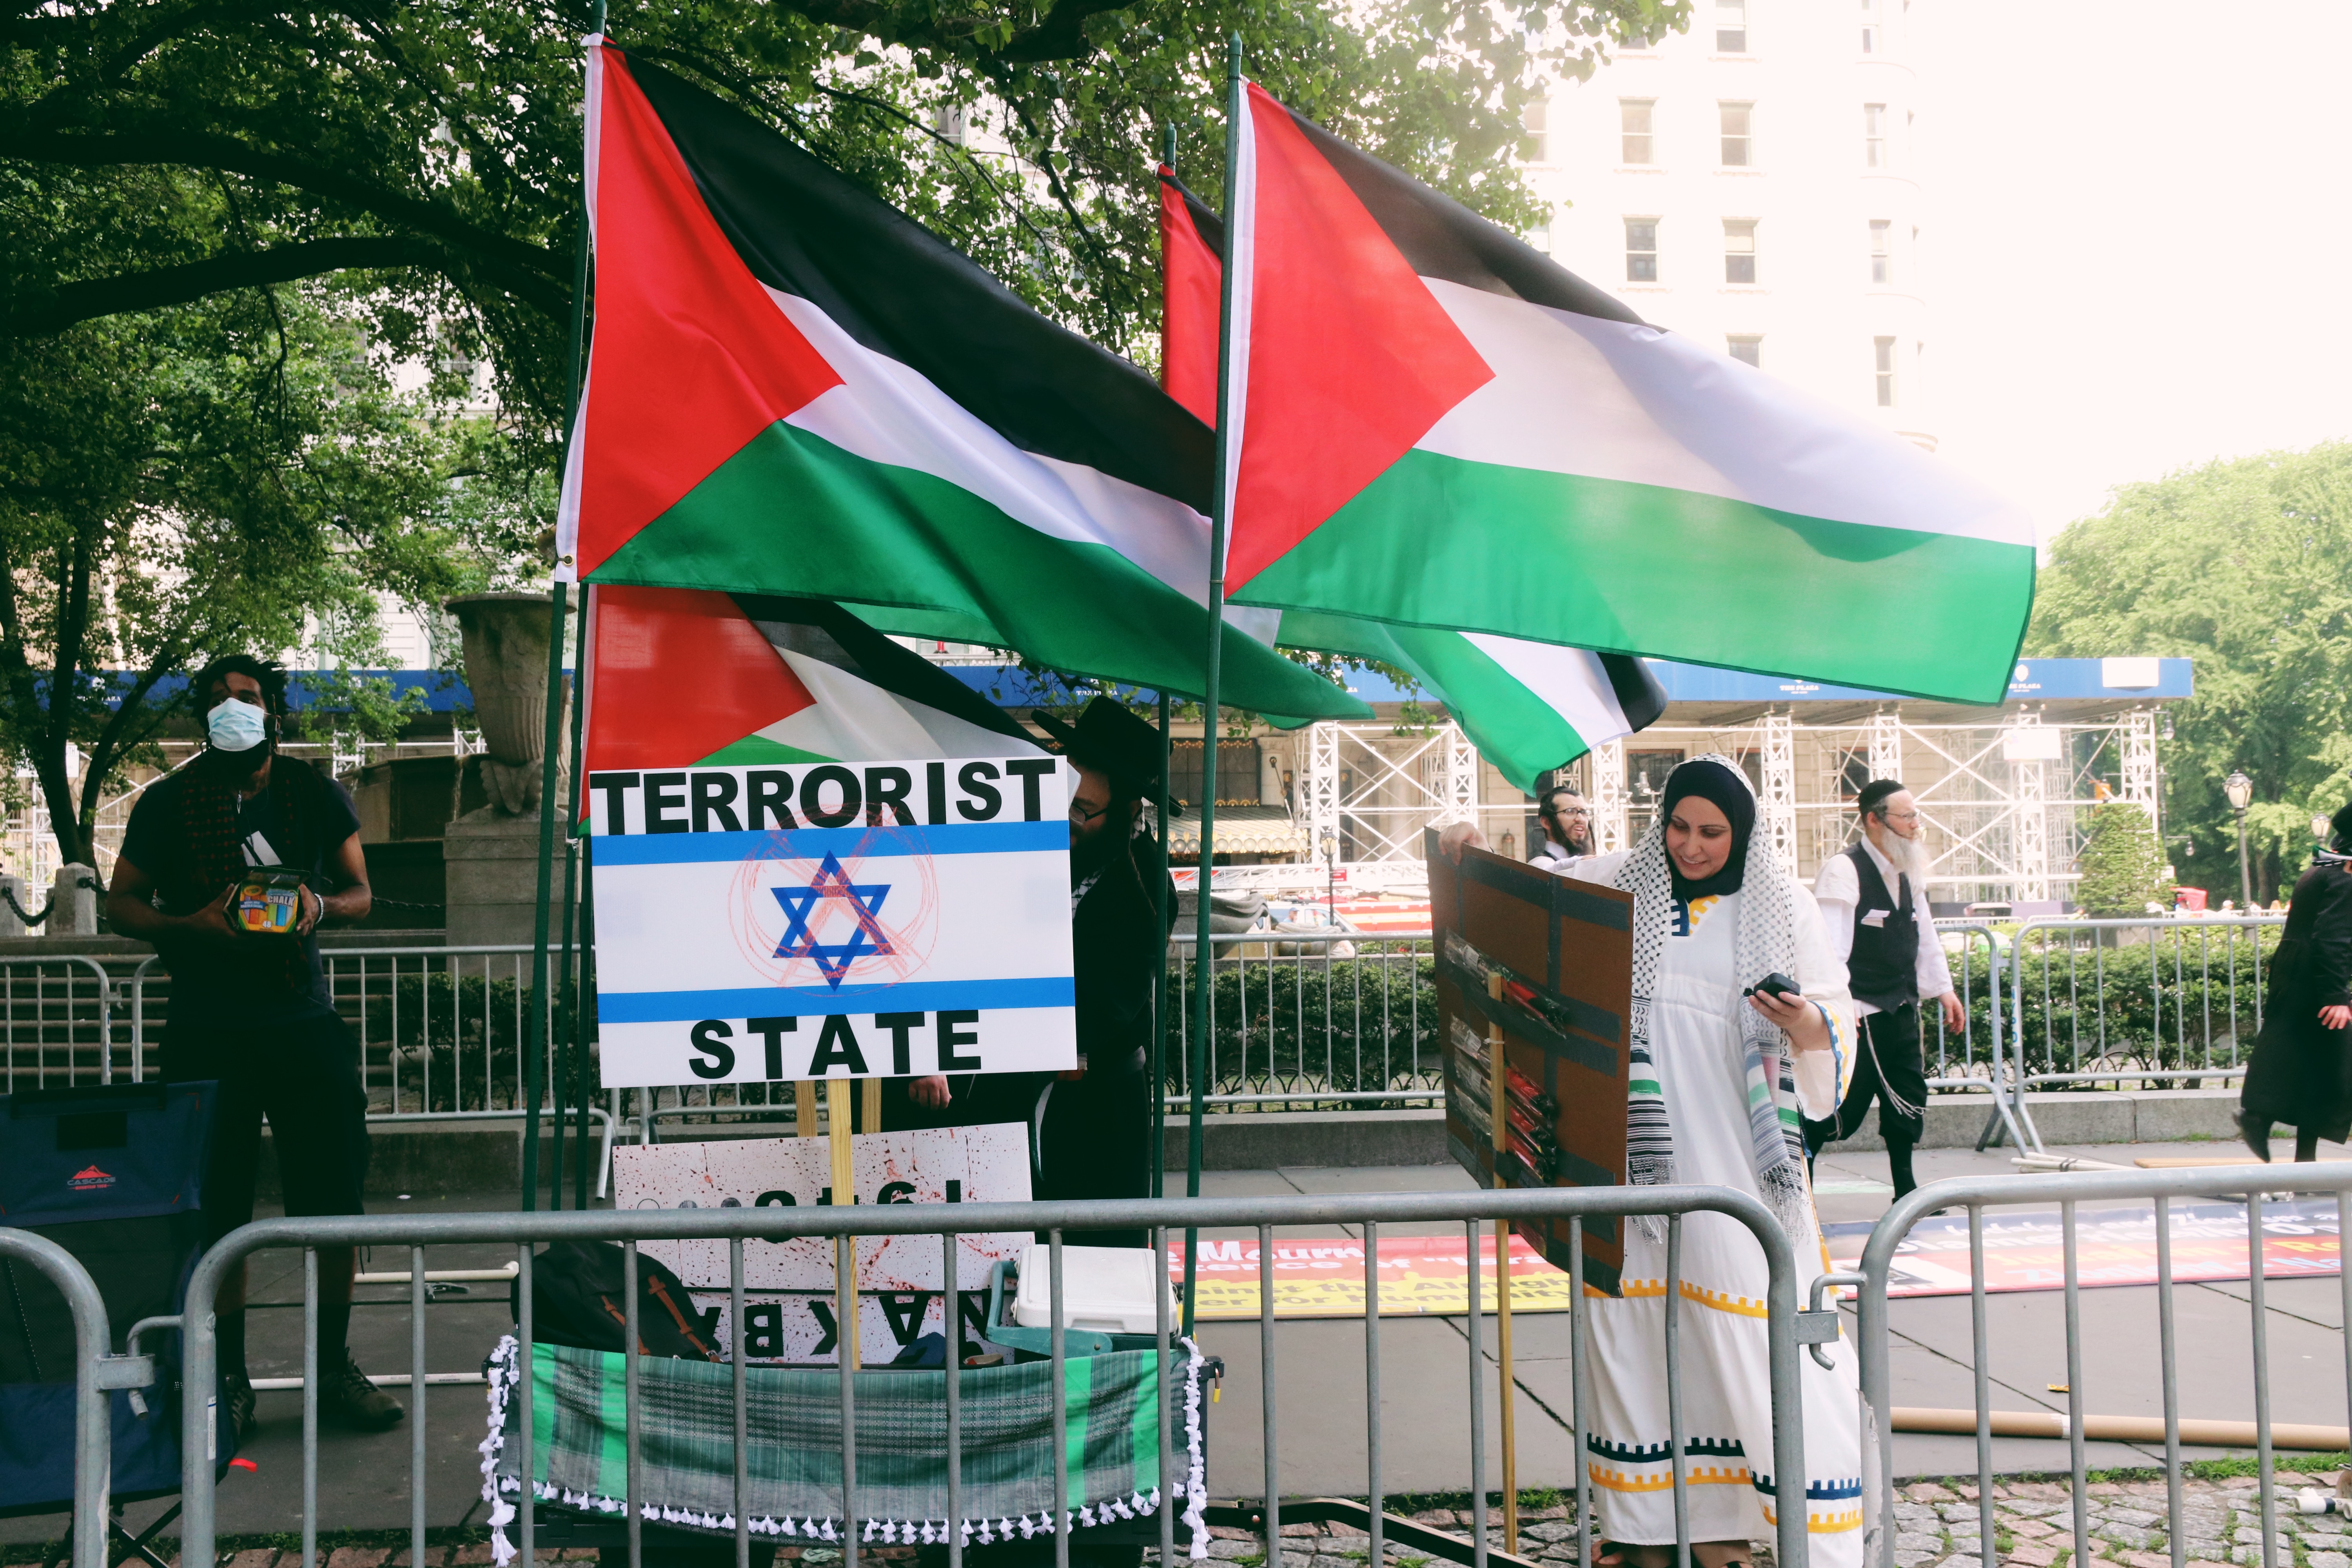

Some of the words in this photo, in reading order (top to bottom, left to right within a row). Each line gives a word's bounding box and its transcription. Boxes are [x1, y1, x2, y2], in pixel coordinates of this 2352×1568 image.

[590, 759, 1056, 836] TERRORIST
[268, 896, 295, 907] CHALK
[688, 1009, 982, 1079] STATE
[67, 1177, 116, 1185] CASCADE
[1895, 1226, 2249, 1252] Diamerically
[1196, 1241, 1365, 1261] Mourn
[1359, 1259, 1410, 1268] of
[1318, 1282, 1395, 1292] the
